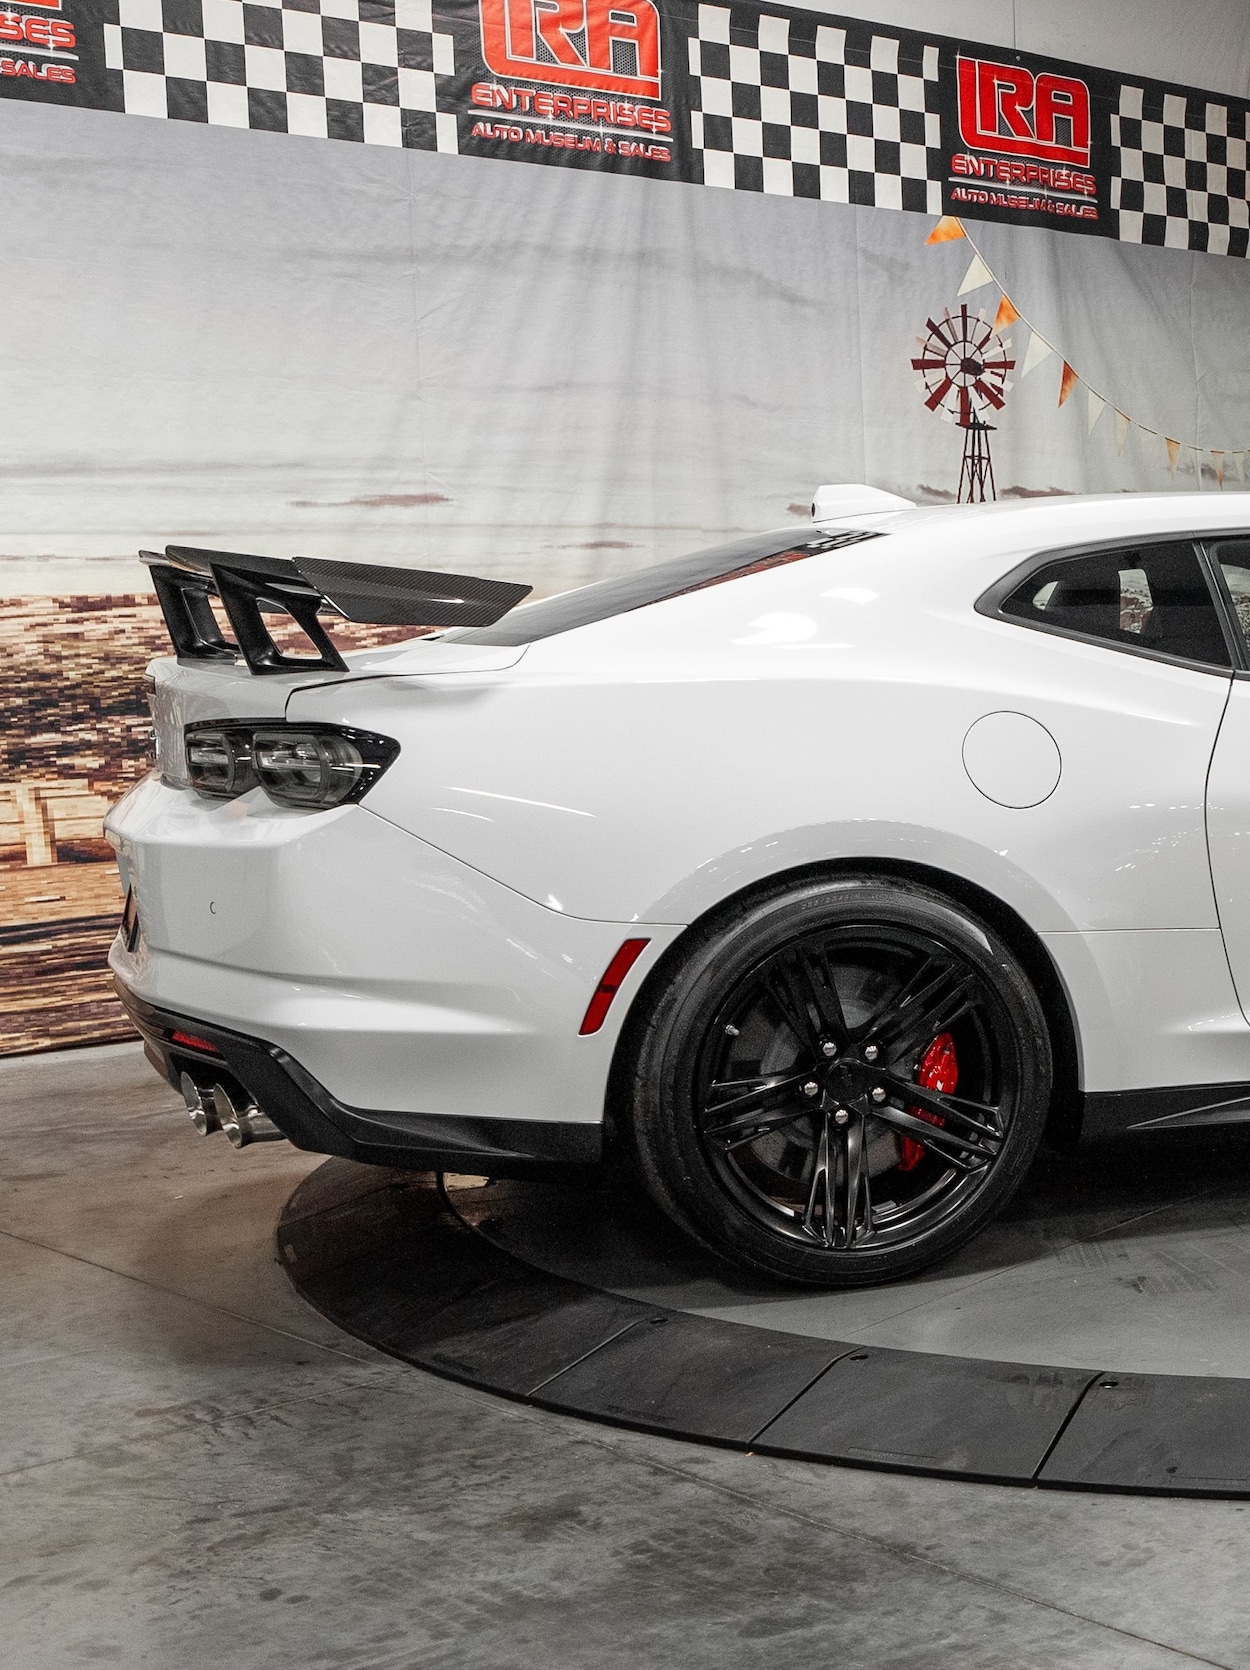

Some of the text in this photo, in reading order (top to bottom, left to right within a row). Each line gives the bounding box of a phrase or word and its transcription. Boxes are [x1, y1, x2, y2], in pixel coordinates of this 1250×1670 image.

[0, 57, 76, 84] SALES
[470, 82, 672, 132] ENTERPRISES
[471, 122, 671, 162] AUTO MUSEUM & SALES
[951, 153, 1097, 195] ENTERPRISES
[951, 187, 988, 203] AUTO
[989, 192, 1047, 211] MUSEUM
[1056, 202, 1099, 220] SALES
